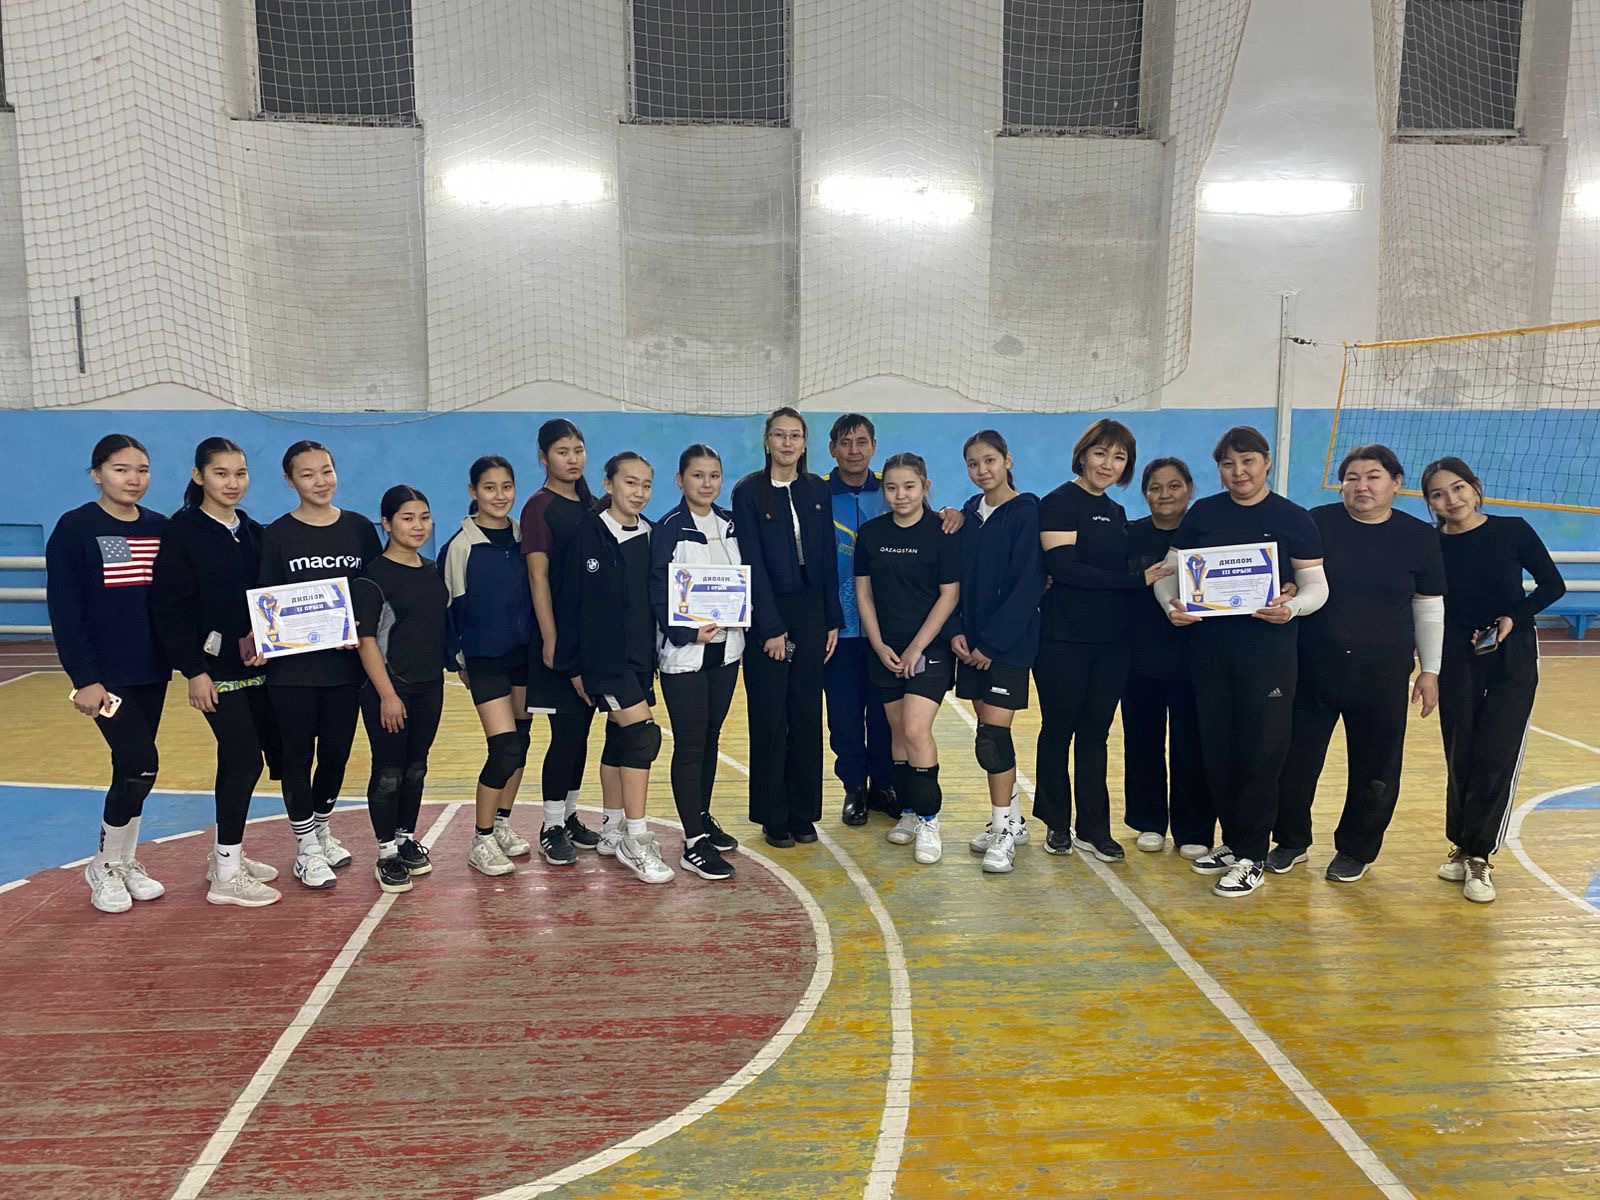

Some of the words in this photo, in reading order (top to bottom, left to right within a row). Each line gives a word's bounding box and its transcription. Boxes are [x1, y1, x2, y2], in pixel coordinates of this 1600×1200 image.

[880, 546, 918, 554] QAZAQSTAN
[289, 555, 362, 572] macron
[1219, 557, 1253, 566] ДИПЛОМ
[291, 593, 325, 604] ДИПЛОМ
